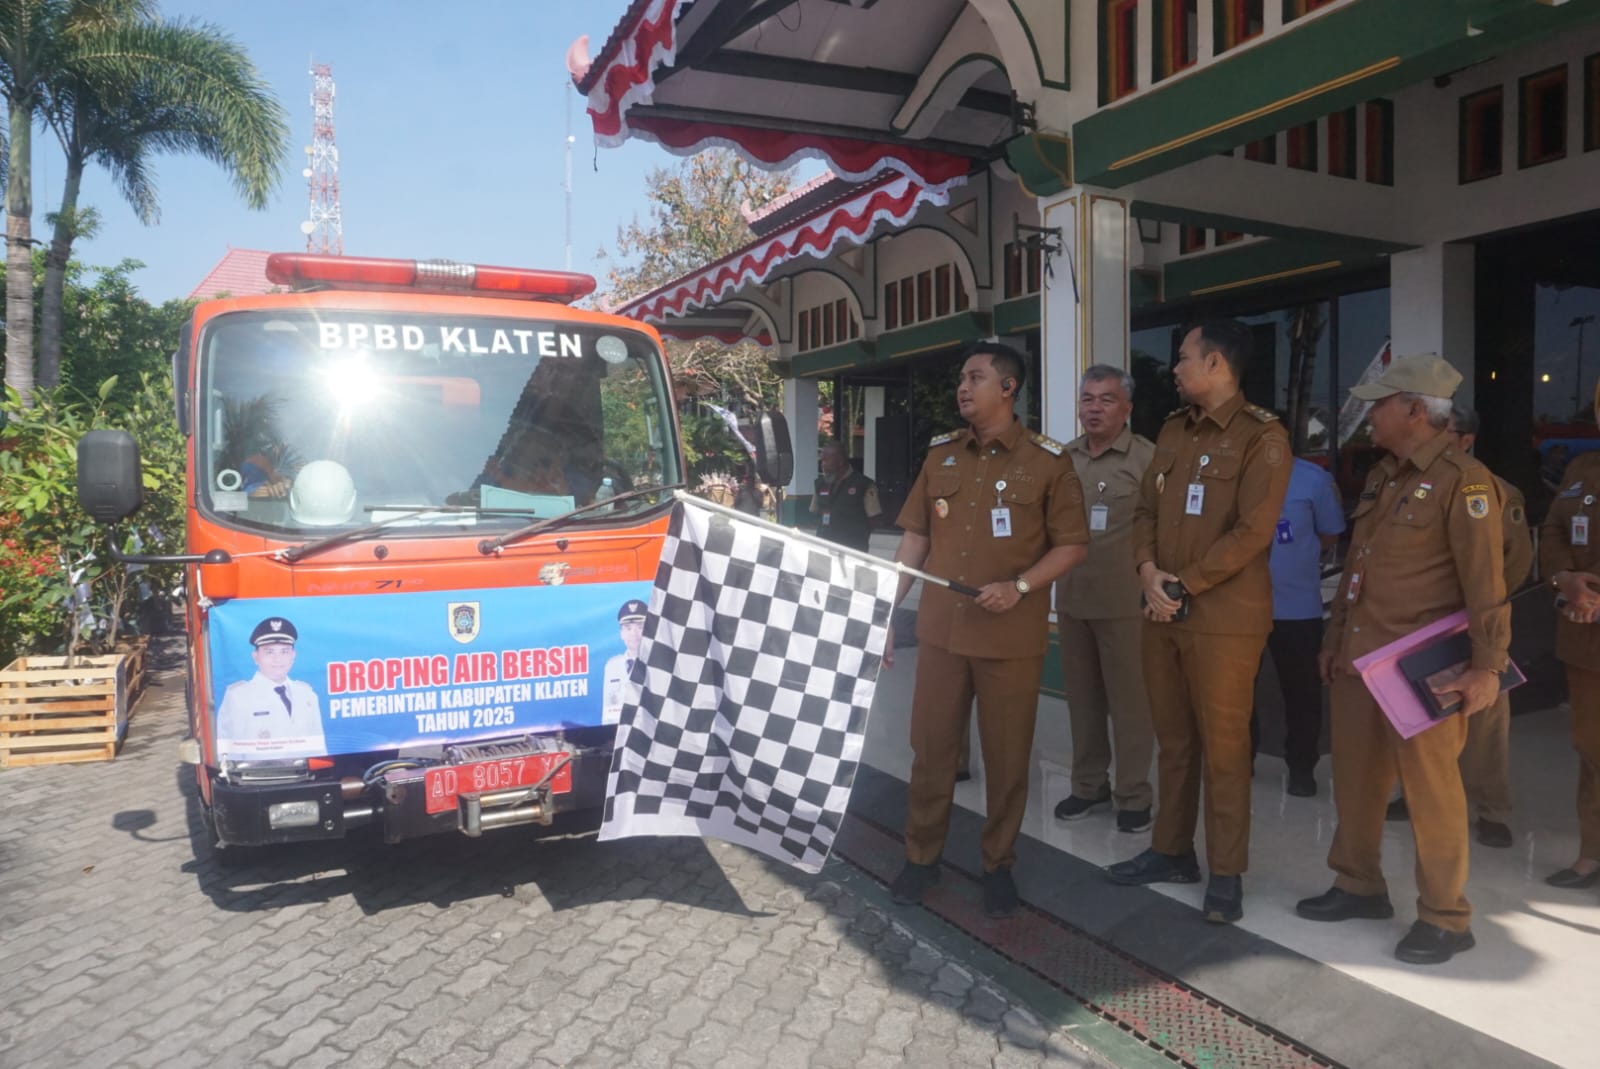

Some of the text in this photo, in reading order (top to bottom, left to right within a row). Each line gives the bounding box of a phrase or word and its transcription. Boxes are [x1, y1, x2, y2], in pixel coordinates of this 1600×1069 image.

[318, 321, 583, 358] BPBD KLATEN
[327, 644, 589, 695] DROPING AIR BERSIH
[329, 678, 588, 719] PEMERINTAH KABUPATEN KLATEN
[415, 706, 515, 734] TAHUN 2025
[432, 769, 458, 798] AD
[472, 759, 526, 789] 8057
